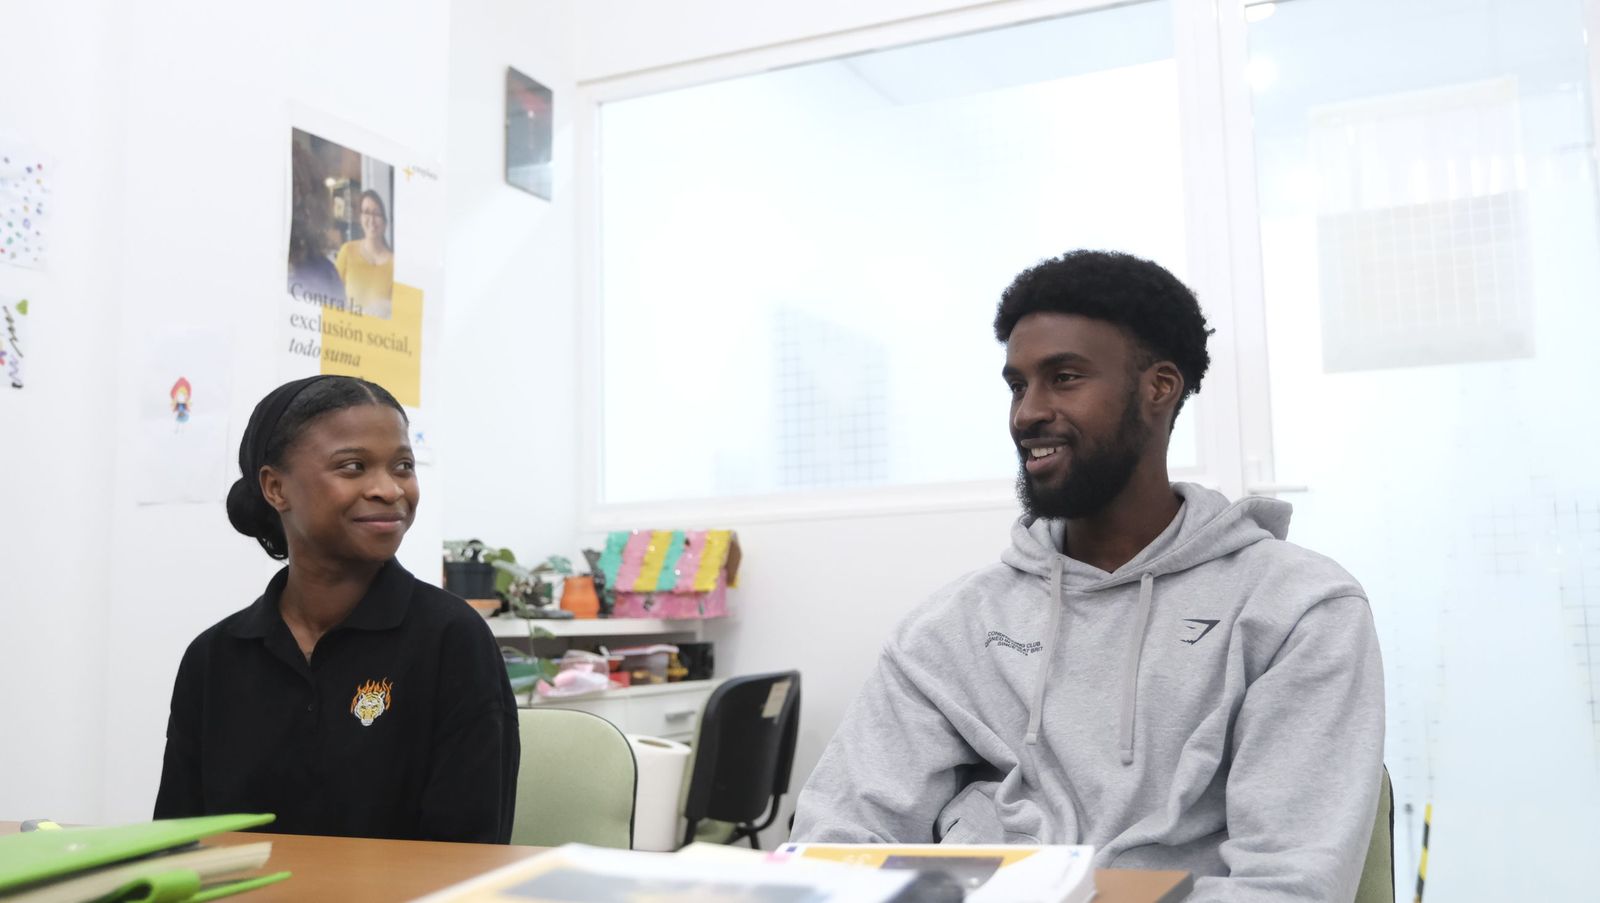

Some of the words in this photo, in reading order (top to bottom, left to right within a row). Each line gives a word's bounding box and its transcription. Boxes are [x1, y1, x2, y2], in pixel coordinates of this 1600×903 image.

[290, 282, 345, 312] Contra
[350, 297, 363, 317] la
[288, 337, 321, 358] todo
[323, 348, 361, 367] suma
[290, 313, 363, 343] exclusión
[367, 332, 412, 357] social,
